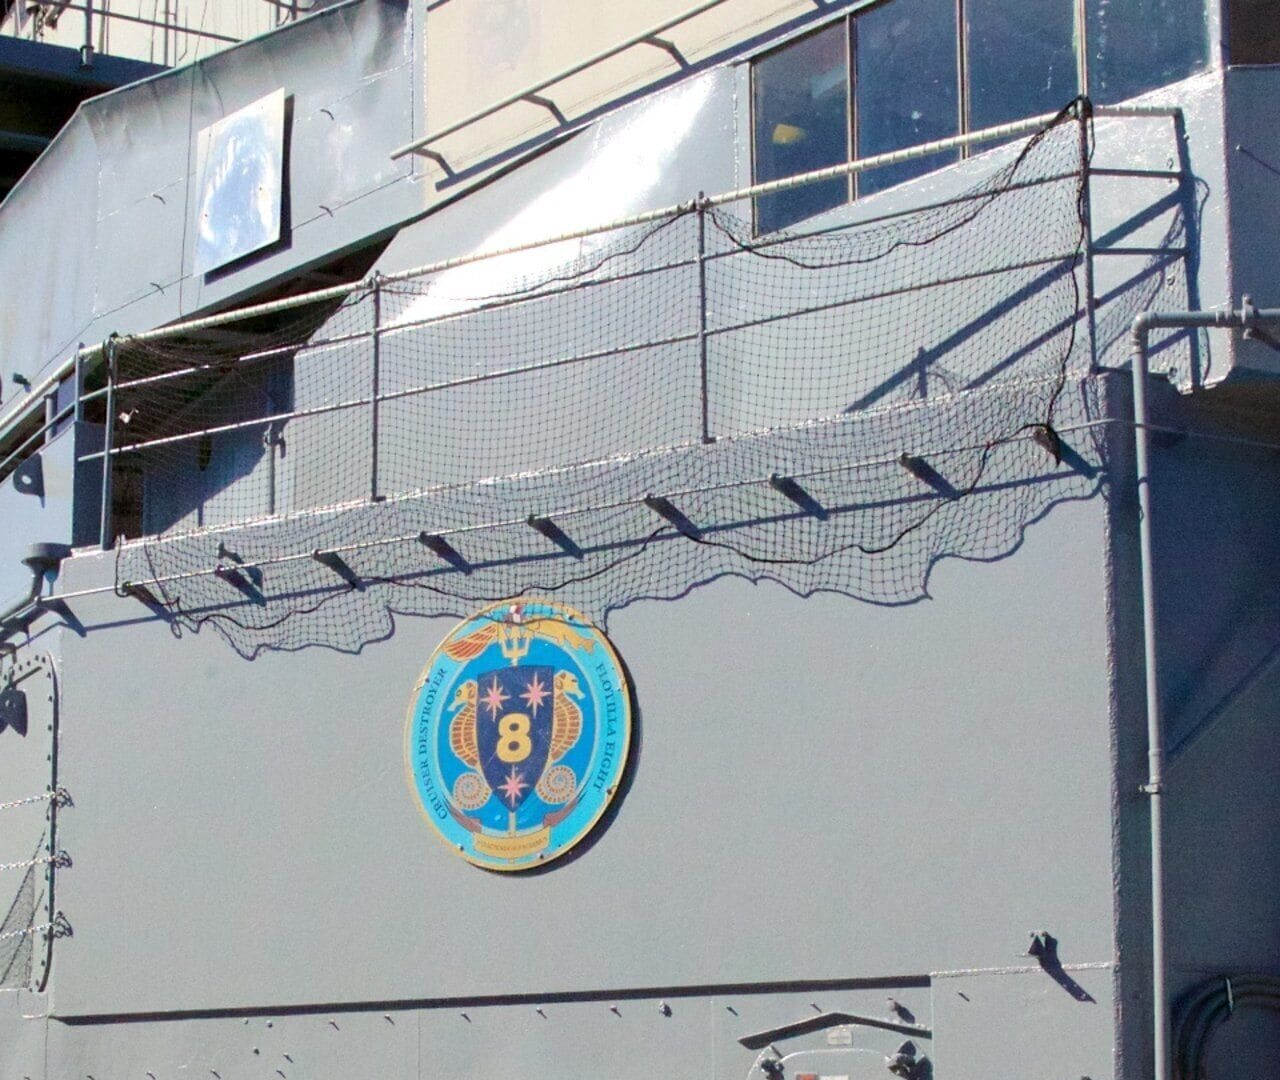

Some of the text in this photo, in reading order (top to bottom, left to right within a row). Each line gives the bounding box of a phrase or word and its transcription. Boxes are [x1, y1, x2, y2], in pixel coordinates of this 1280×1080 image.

[418, 668, 448, 821] CRUISER DESTROYER
[496, 713, 531, 763] 8
[593, 663, 617, 793] FLOTILLA EIGHT
